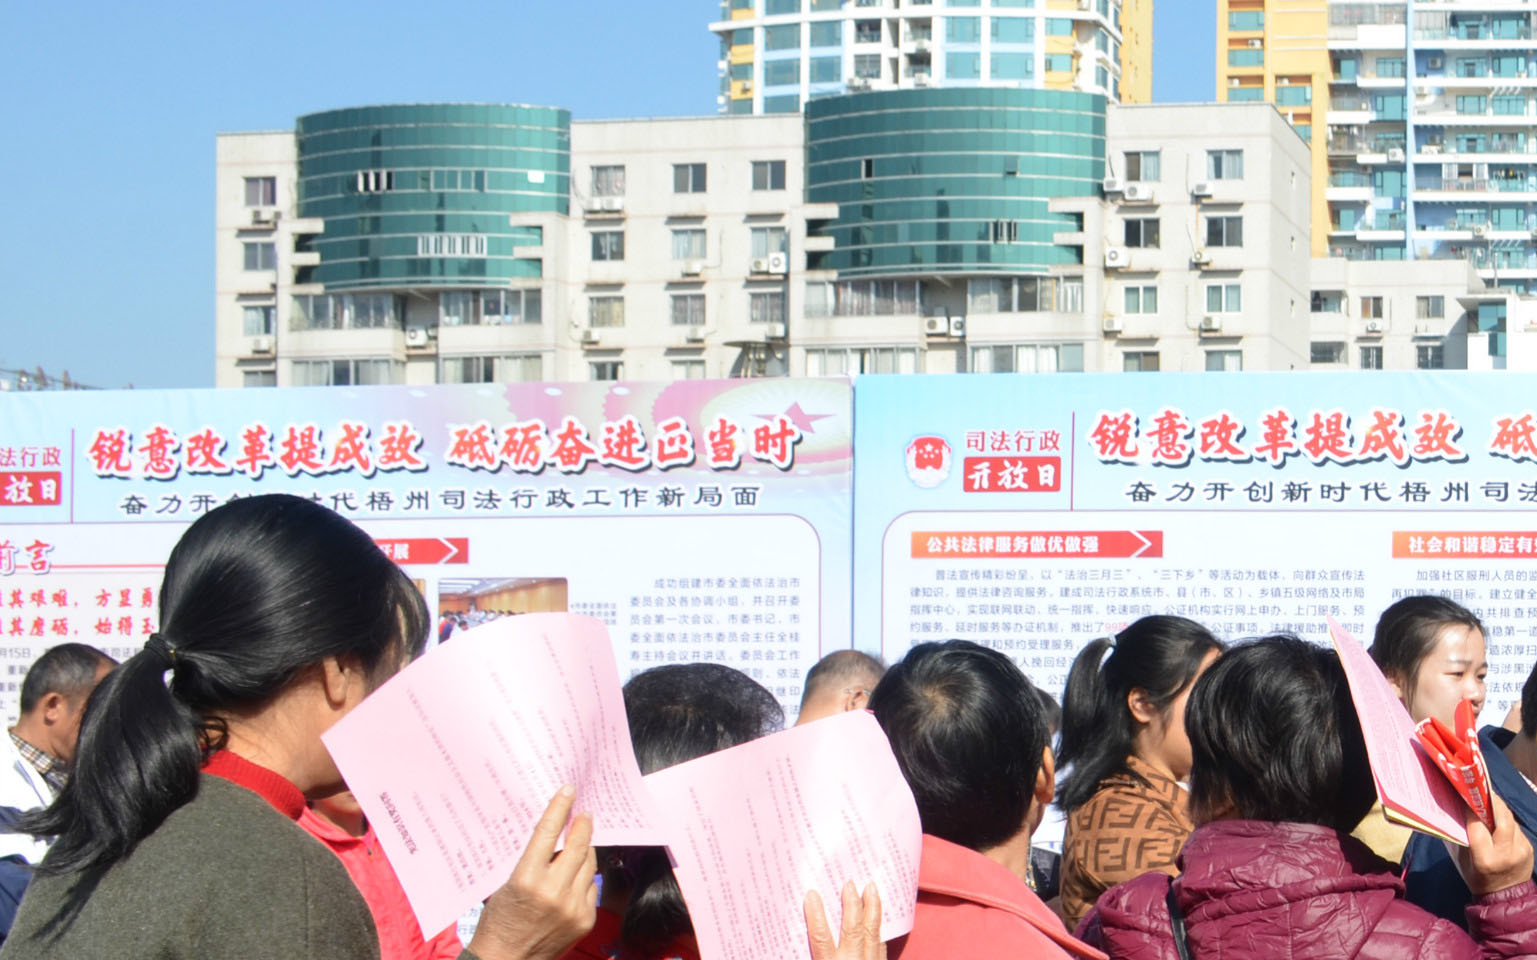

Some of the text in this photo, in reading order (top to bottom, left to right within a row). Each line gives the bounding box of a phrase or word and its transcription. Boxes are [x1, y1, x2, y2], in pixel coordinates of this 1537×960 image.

[87, 418, 797, 474] 锐意改革提成效 砥砺奋进正当时
[965, 430, 1062, 453] 司法行政
[1090, 409, 1464, 463] 锐意改革提成效
[966, 460, 1056, 491] 开放日
[925, 535, 1100, 555] 公共法律服务做优做强
